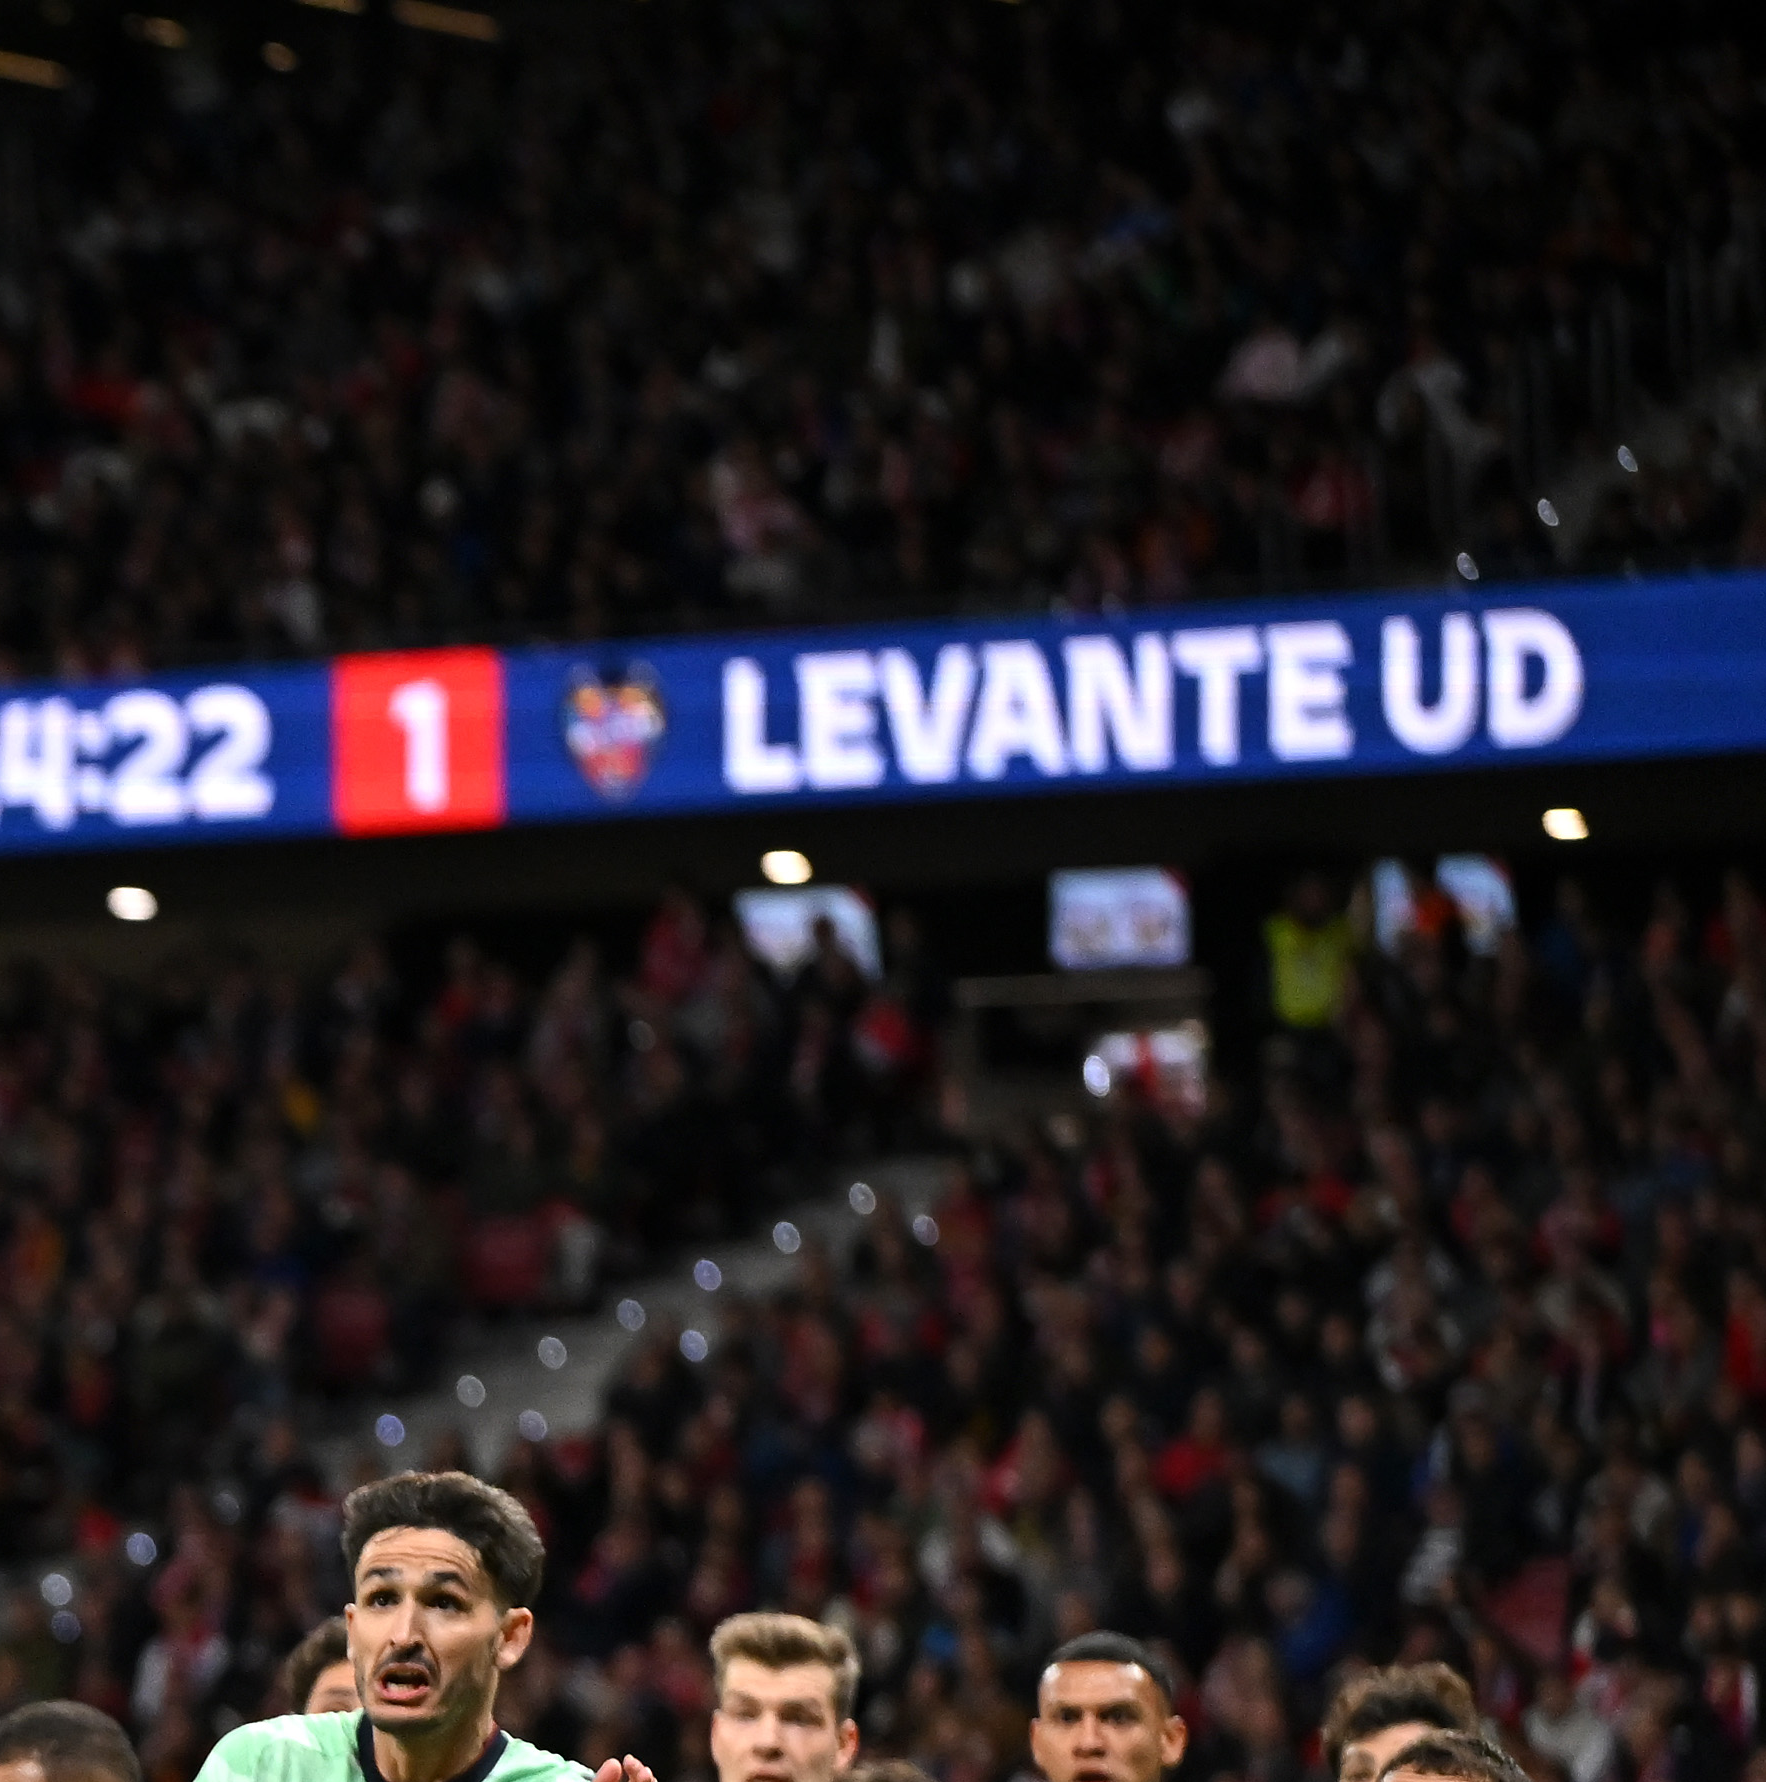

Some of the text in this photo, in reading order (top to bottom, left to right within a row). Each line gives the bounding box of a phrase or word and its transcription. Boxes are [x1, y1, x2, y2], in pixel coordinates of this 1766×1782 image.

[388, 678, 449, 814] 1
[721, 607, 1584, 794] LEVANTE UD
